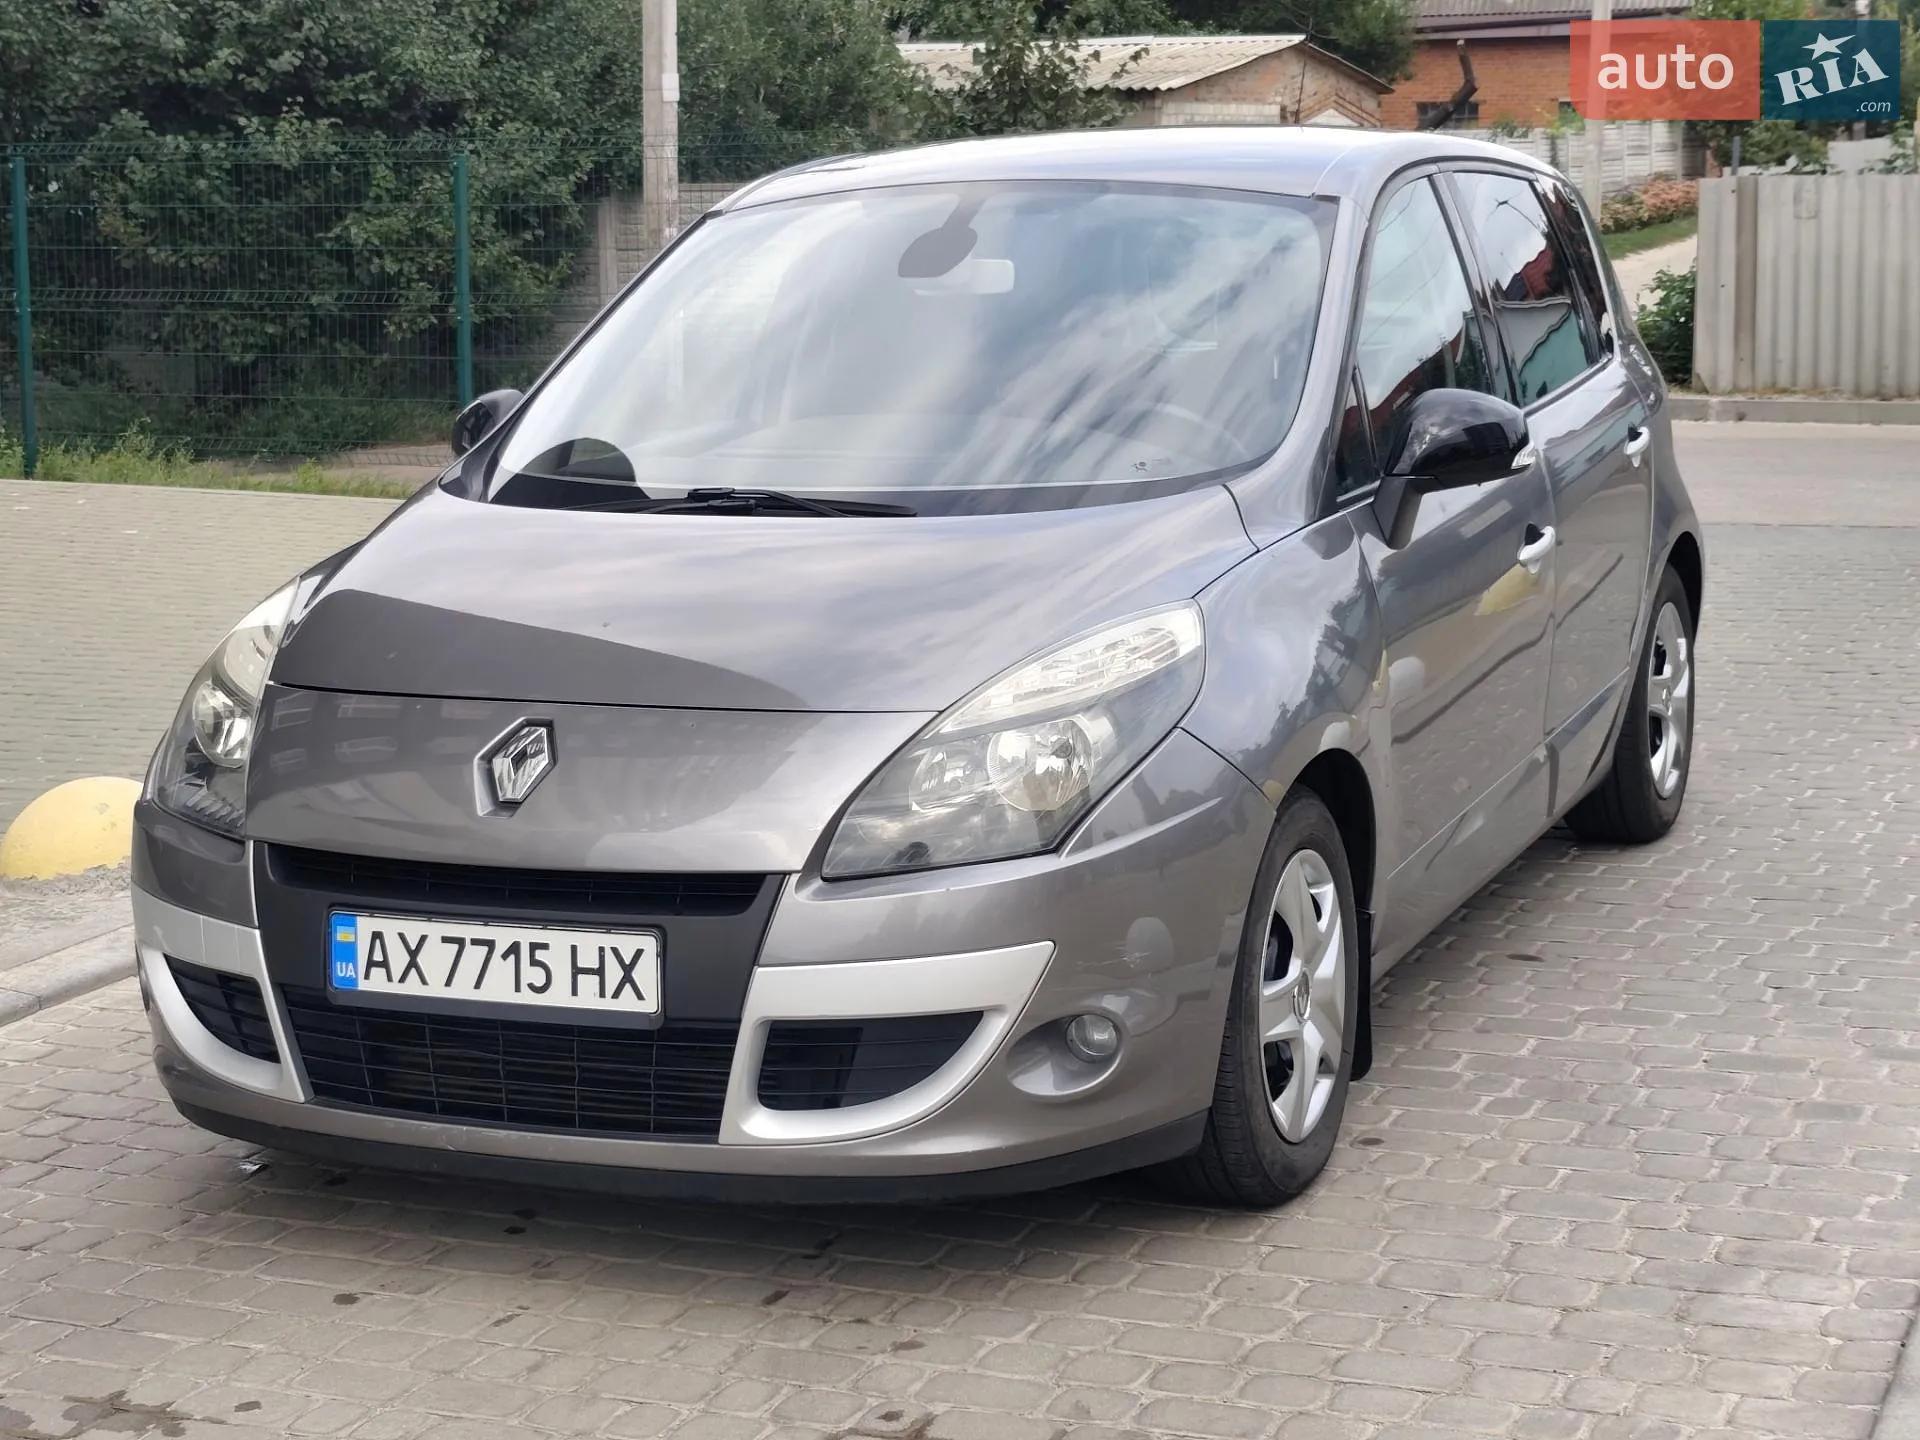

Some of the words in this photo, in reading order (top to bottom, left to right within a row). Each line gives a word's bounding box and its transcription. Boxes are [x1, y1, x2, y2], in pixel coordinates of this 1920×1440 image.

[336, 960, 356, 979] UA
[363, 930, 429, 986] AX
[440, 935, 553, 994] 7715
[569, 944, 646, 1001] HX
